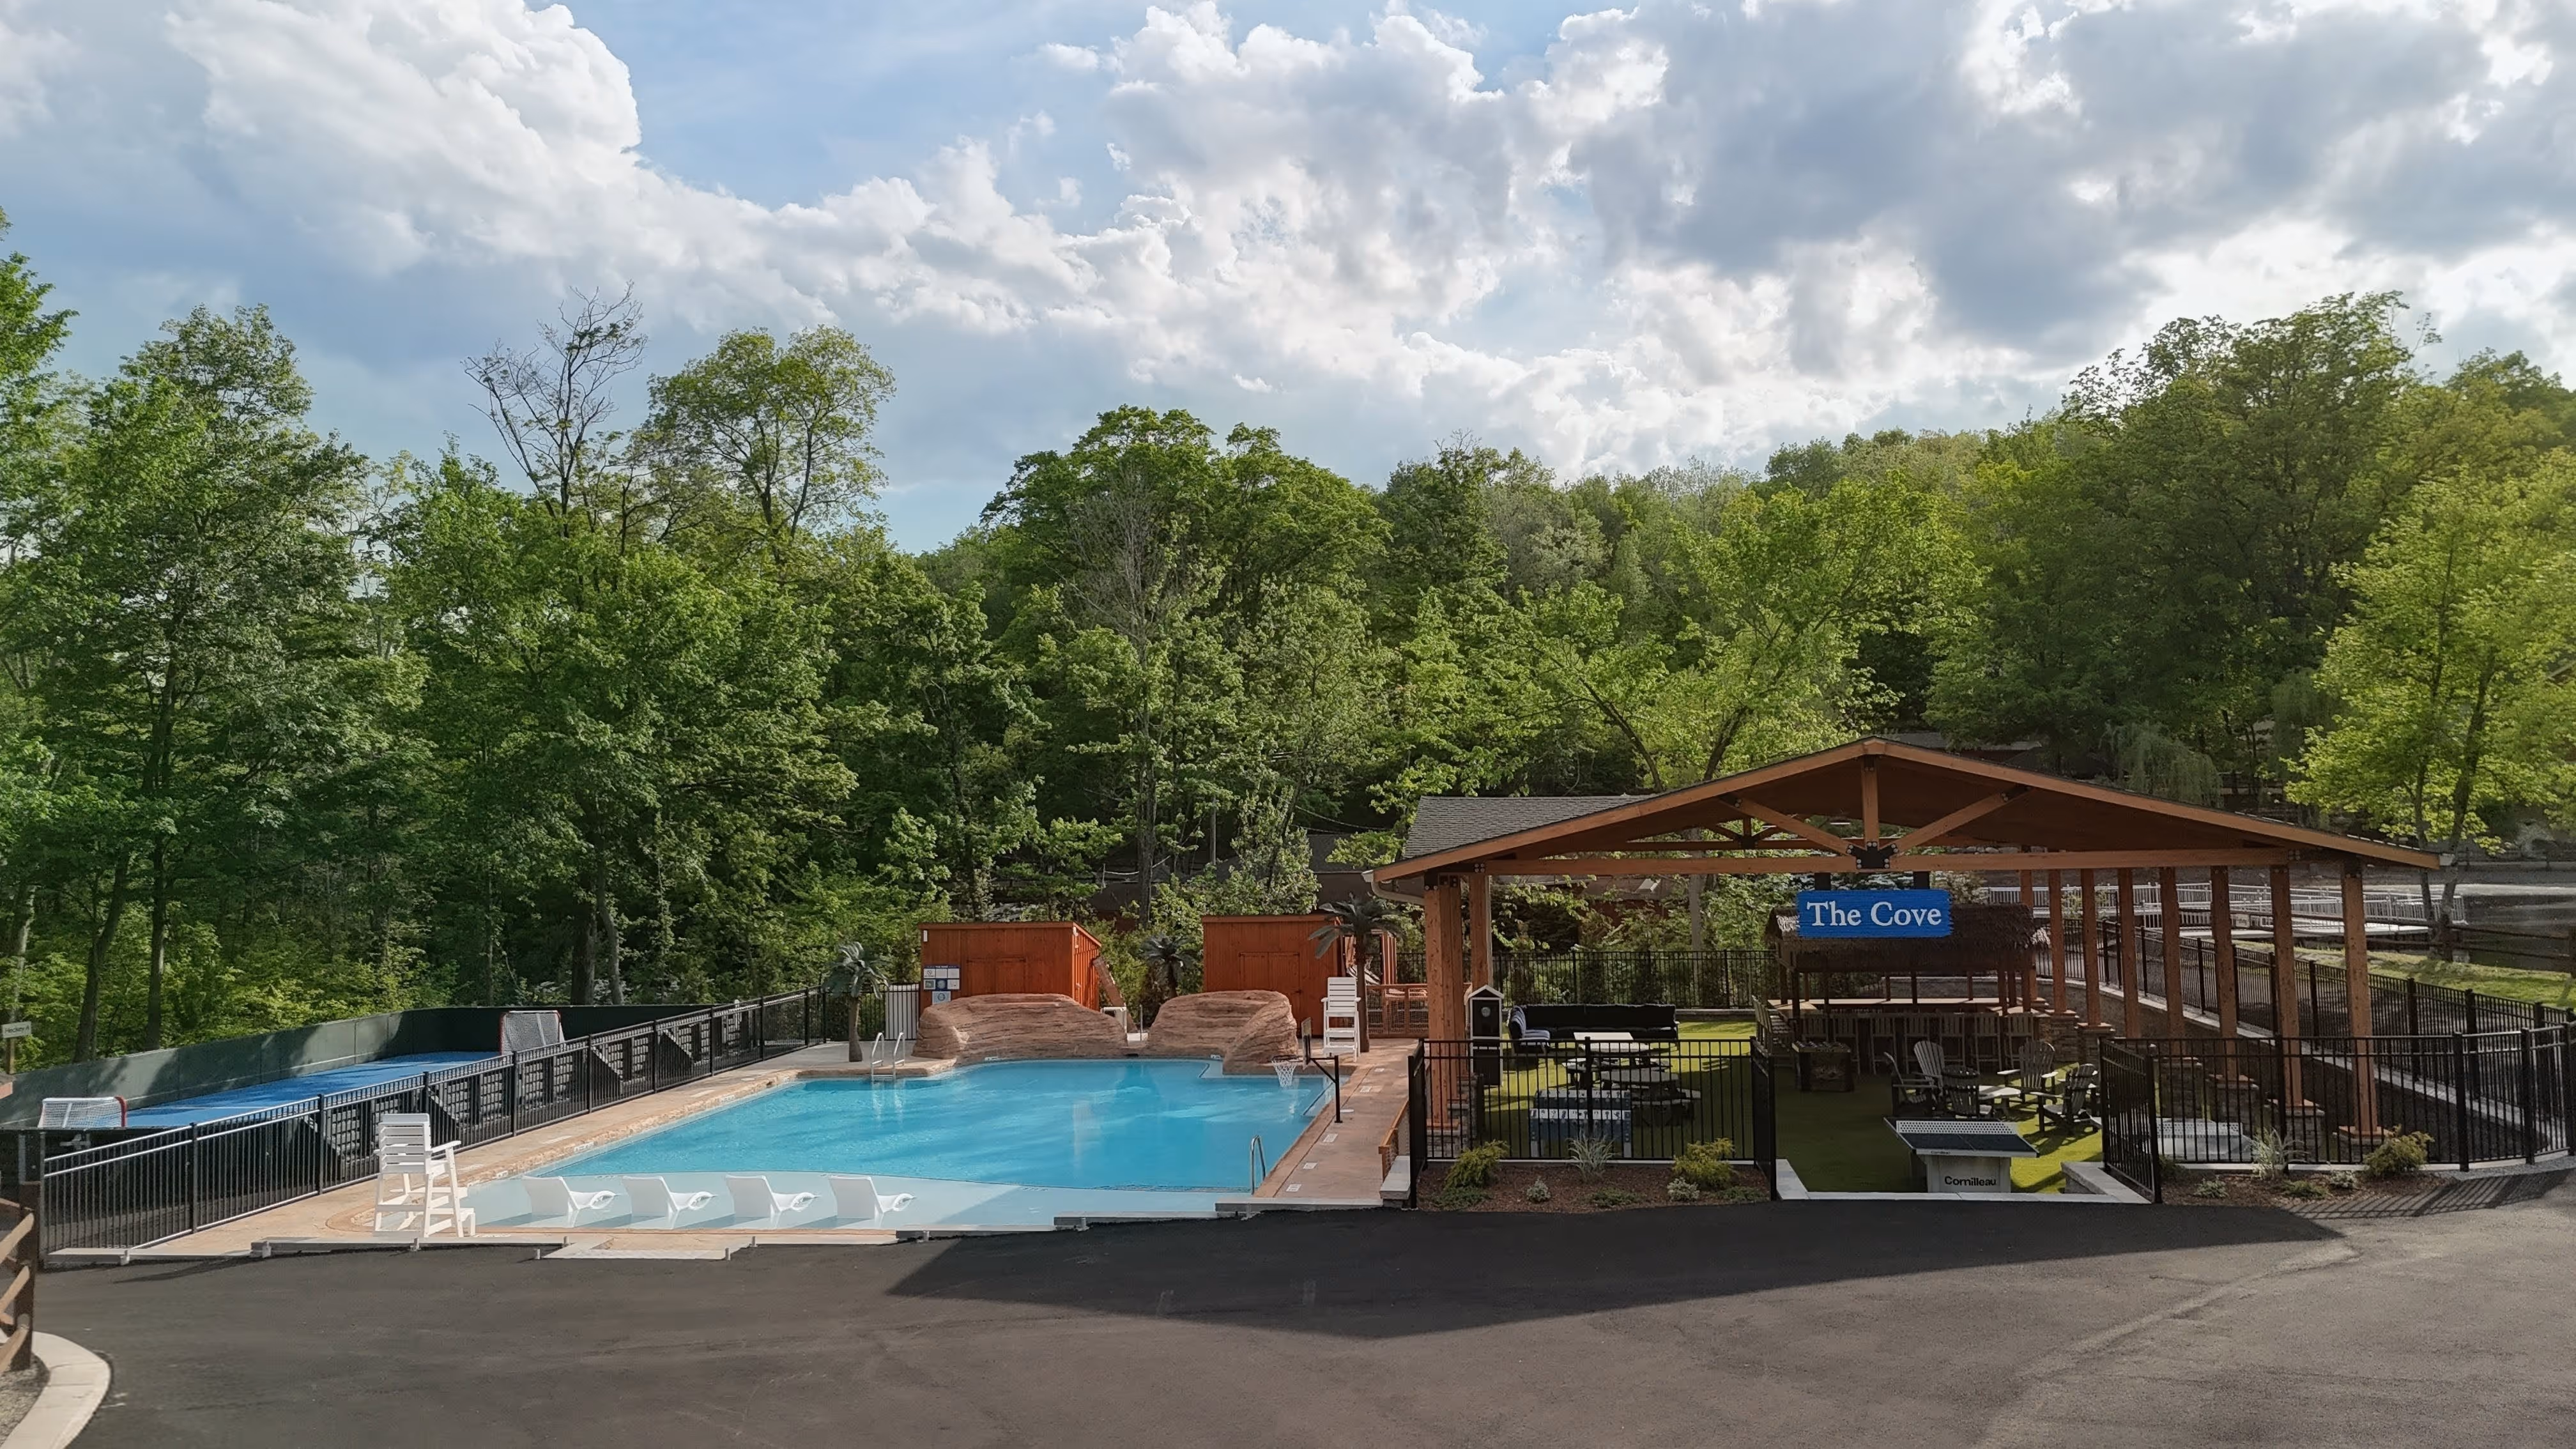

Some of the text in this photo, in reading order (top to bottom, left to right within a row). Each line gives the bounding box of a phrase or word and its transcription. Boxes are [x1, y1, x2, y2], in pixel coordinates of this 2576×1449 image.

[1806, 901, 1942, 926] The Cove
[1944, 1176, 1997, 1186] Cornilleau
